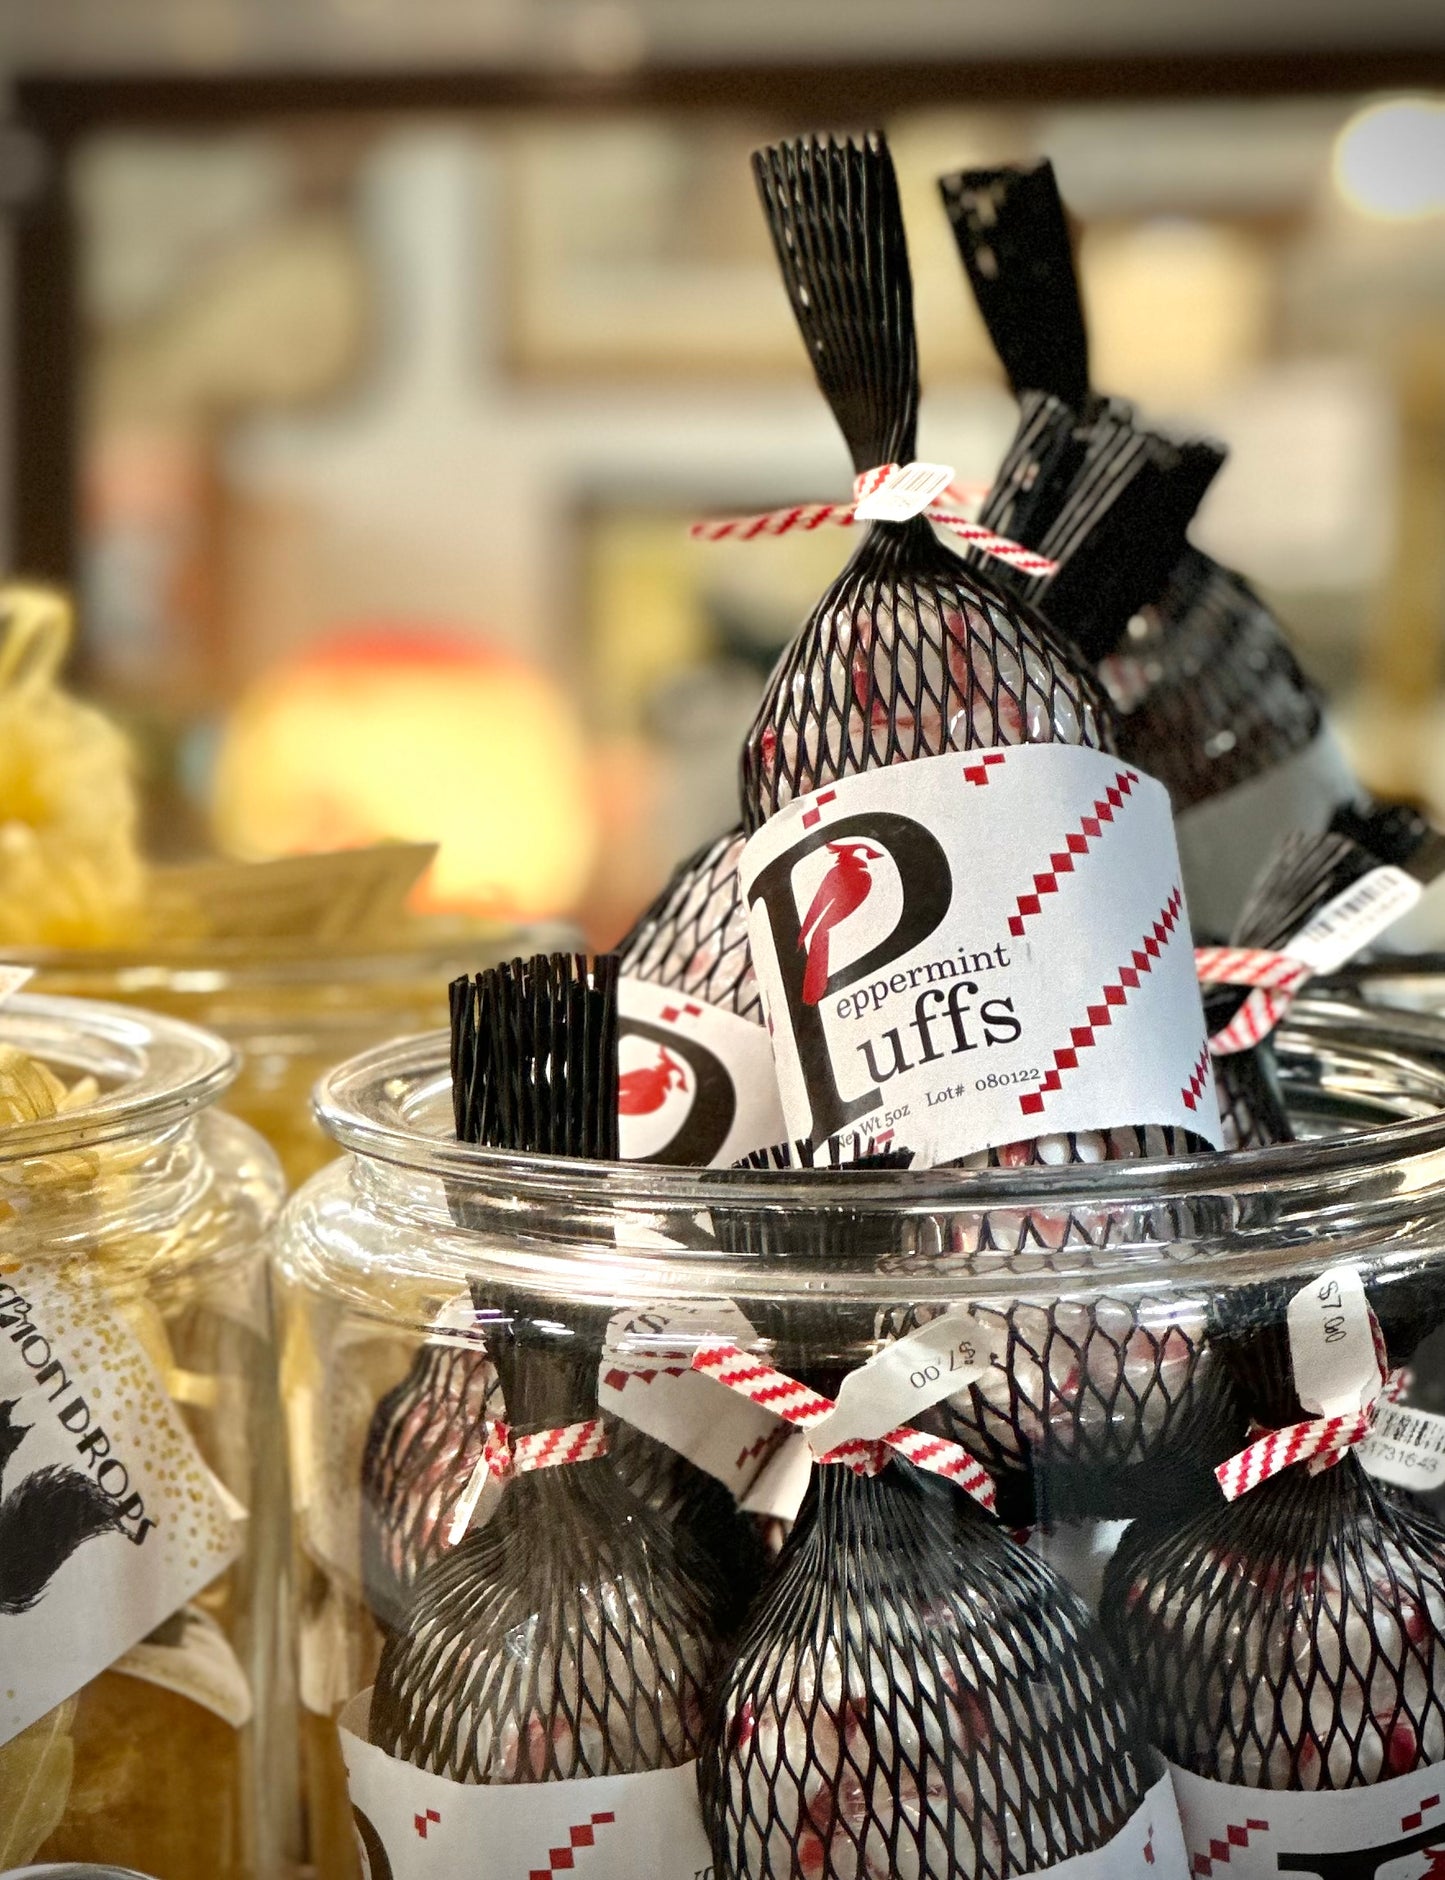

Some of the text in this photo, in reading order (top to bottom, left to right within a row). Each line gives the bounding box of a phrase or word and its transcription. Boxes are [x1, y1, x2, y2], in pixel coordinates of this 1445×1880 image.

[859, 1116, 882, 1136] Wt
[925, 1083, 966, 1107] Lot#
[975, 1068, 1042, 1092] 080122
[57, 1395, 157, 1546] DROPS
